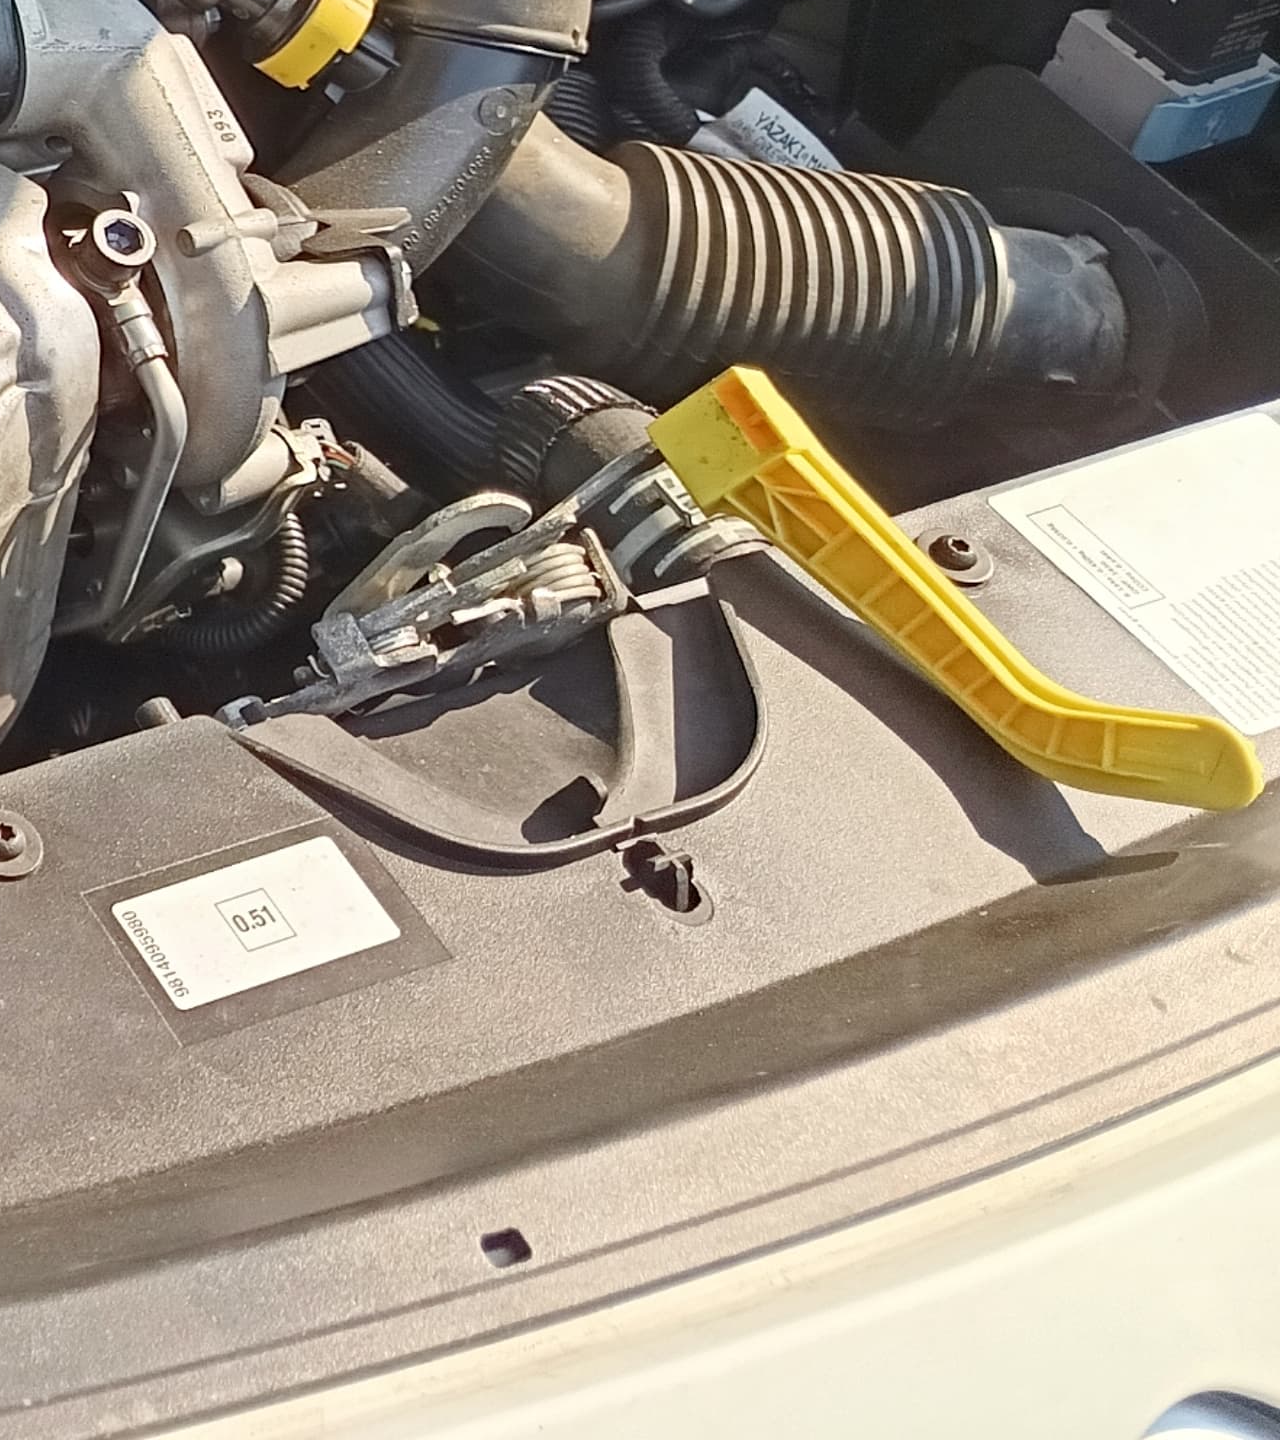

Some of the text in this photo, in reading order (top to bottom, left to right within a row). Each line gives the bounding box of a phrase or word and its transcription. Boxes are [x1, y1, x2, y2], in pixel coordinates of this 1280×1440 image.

[205, 104, 238, 147] 093
[231, 905, 277, 933] 0.51
[119, 907, 192, 1001] 9814095980
